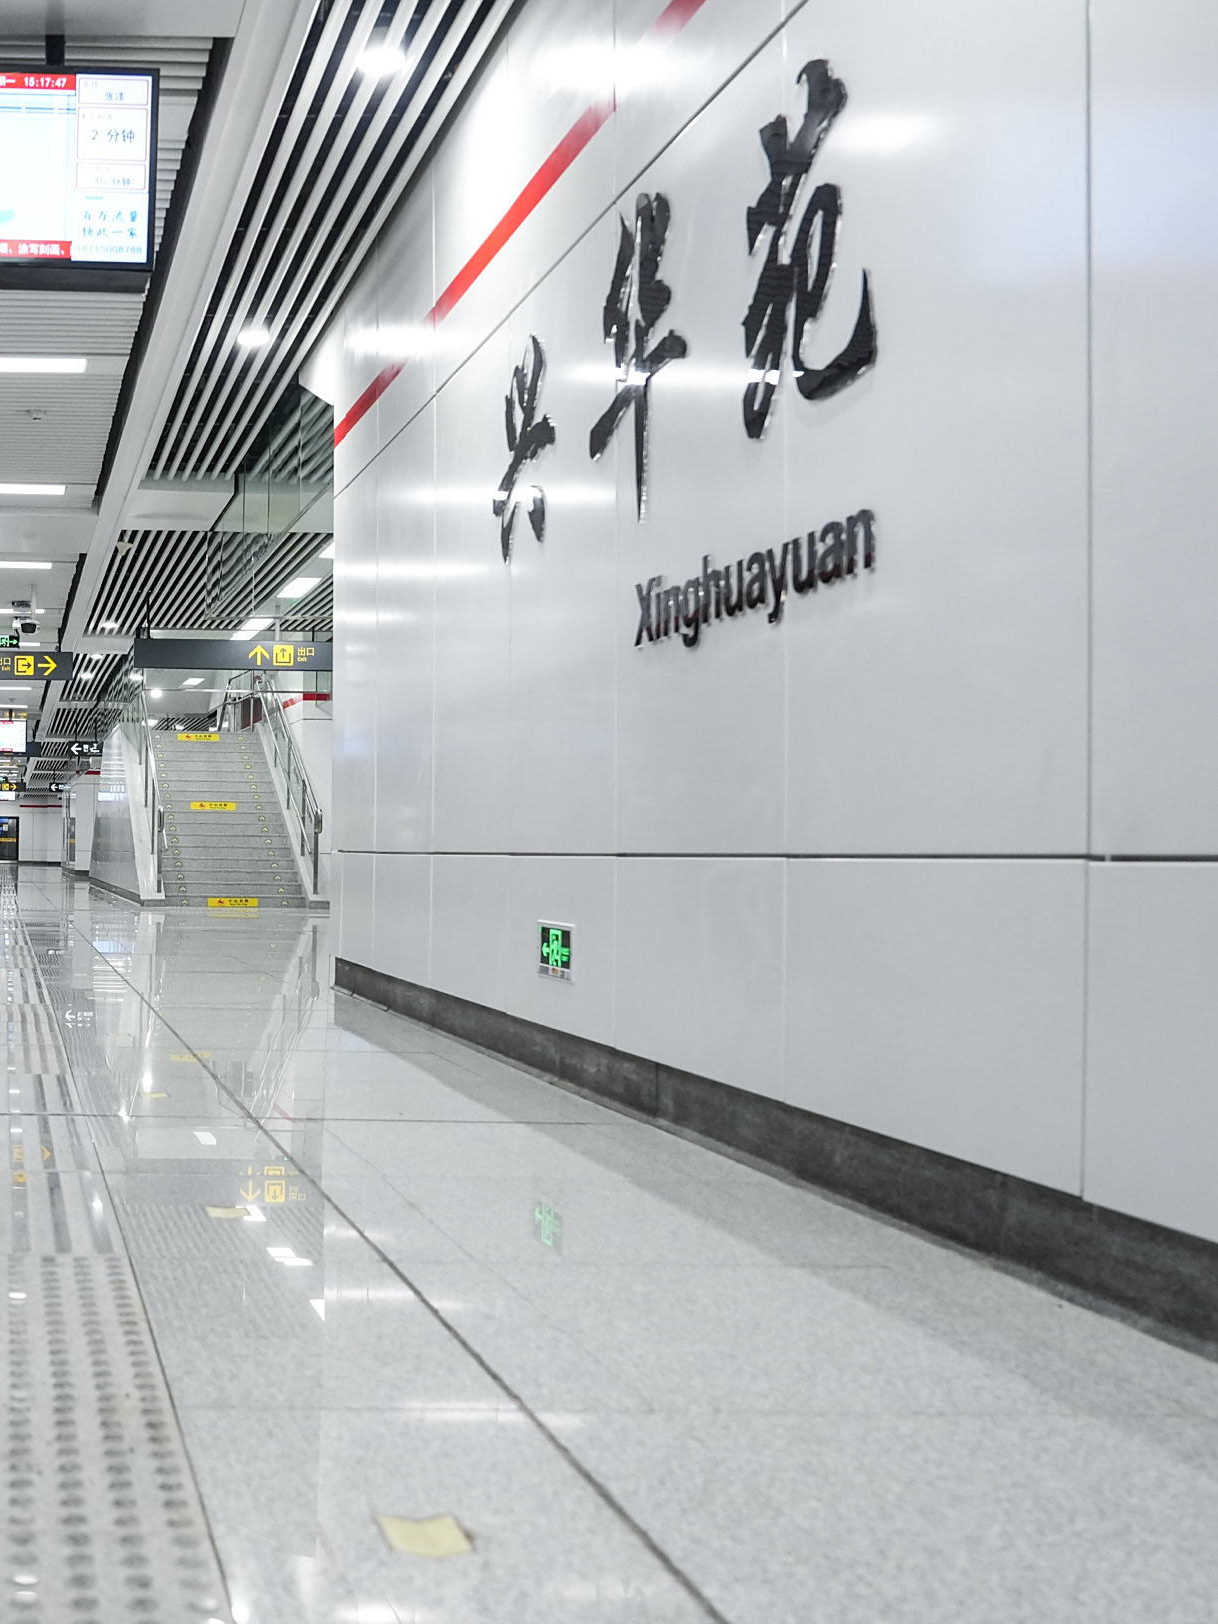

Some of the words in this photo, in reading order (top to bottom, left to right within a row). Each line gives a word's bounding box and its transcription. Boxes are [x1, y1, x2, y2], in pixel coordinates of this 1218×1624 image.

[24, 76, 67, 89] 15:17:47
[91, 129, 99, 142] 2
[106, 128, 136, 144] 分钟
[82, 208, 139, 224] 百万流量
[81, 225, 139, 240] 独此一家
[634, 508, 877, 649] Xinghuayuan
[297, 646, 315, 656] 出口
